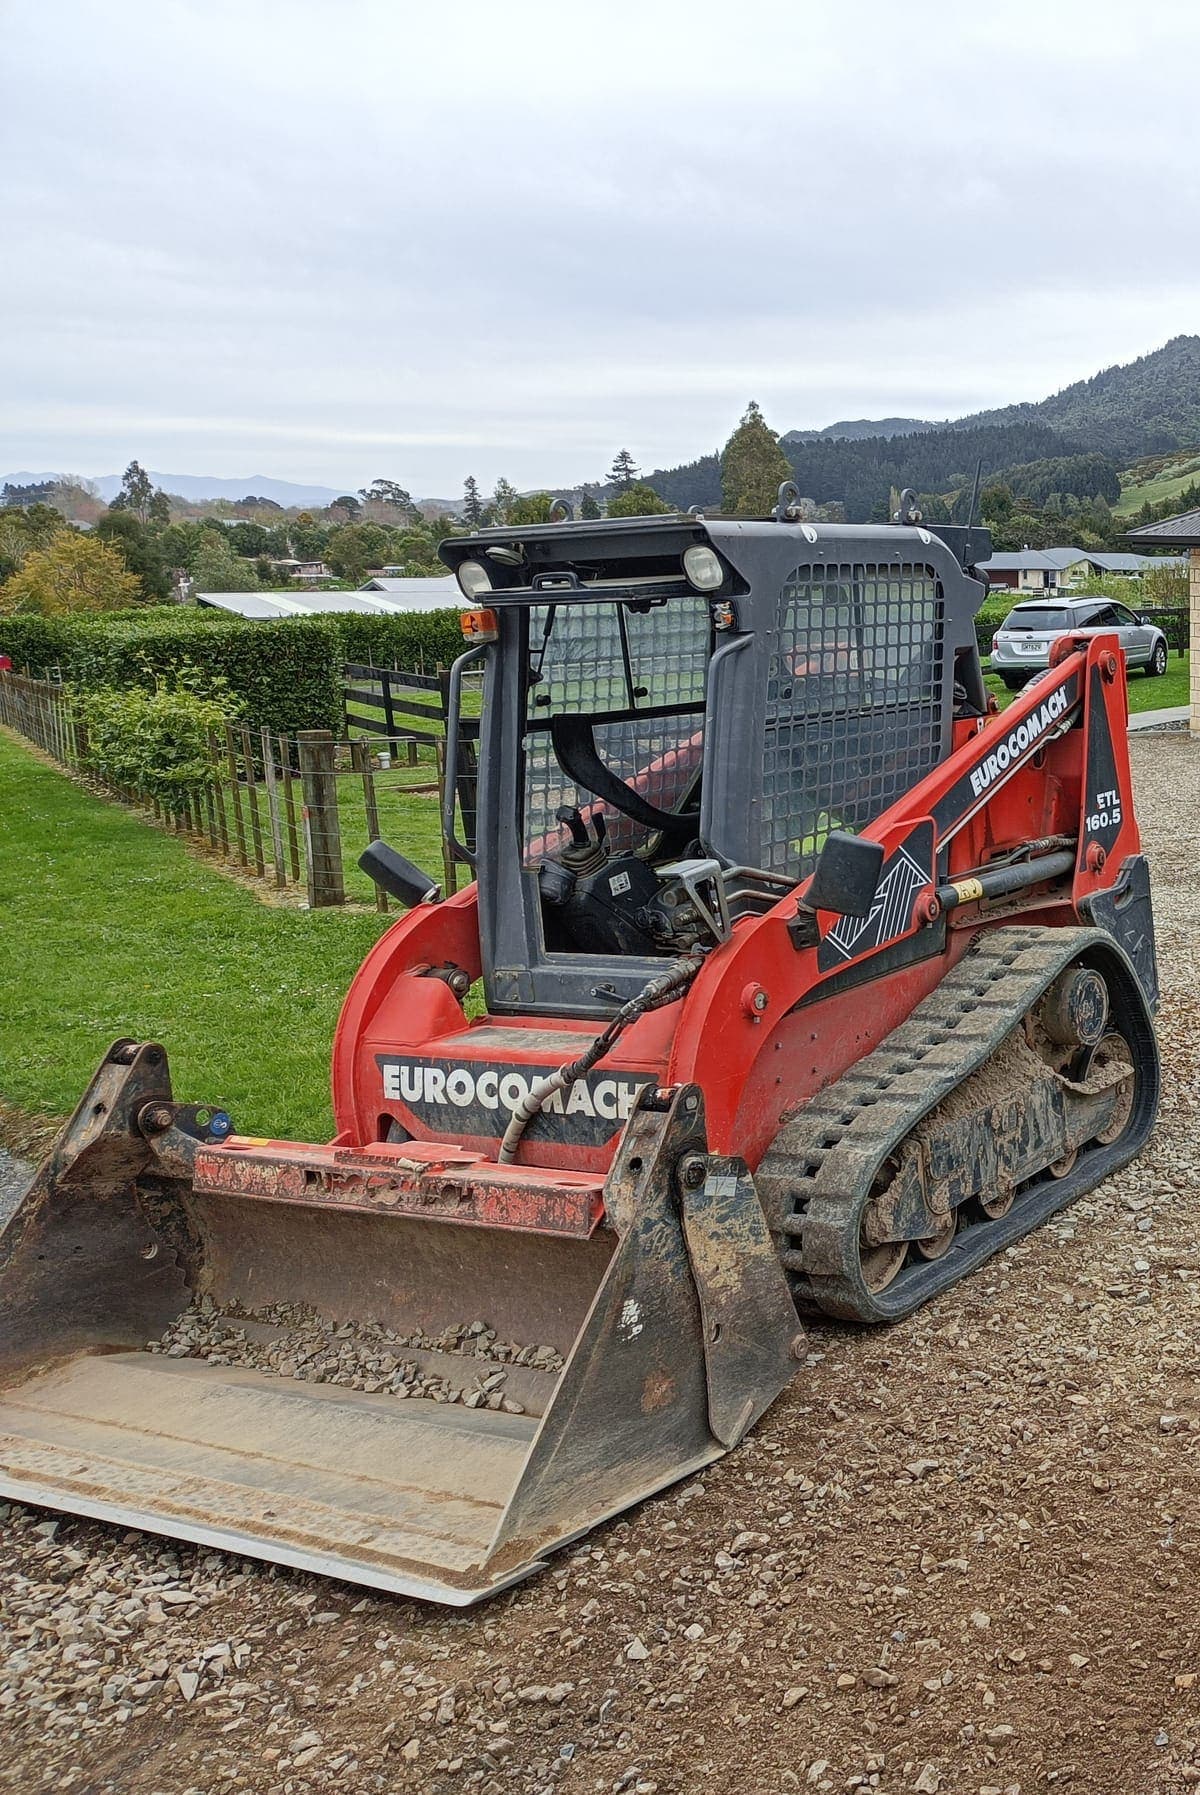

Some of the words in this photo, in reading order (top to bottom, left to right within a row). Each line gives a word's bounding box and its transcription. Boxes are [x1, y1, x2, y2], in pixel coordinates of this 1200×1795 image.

[969, 687, 1068, 797] EUROCOMACH
[1096, 790, 1120, 809] ETL
[1085, 808, 1121, 832] 160.5
